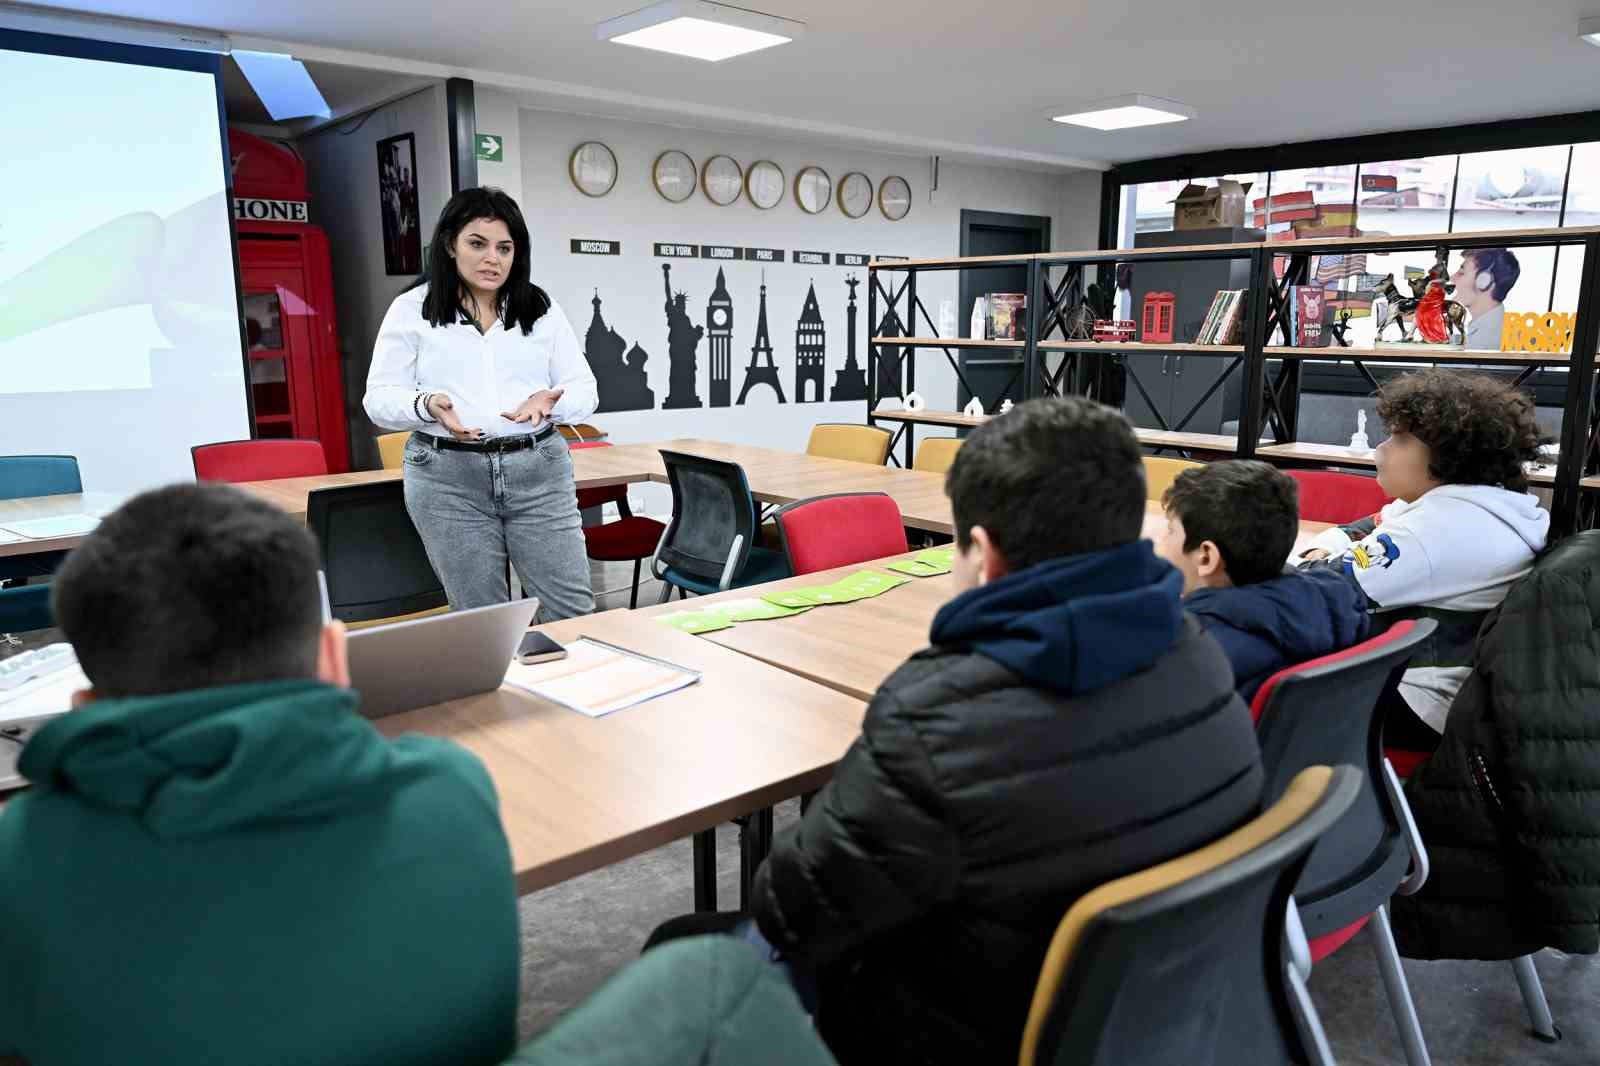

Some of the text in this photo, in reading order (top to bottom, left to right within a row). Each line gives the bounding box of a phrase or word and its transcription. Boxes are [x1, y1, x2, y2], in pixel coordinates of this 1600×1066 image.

[580, 241, 611, 253] MOSCOW
[660, 245, 693, 257] NEW YORK
[710, 247, 735, 258] LONDON
[756, 250, 774, 260] PARIS
[844, 255, 863, 265] BERLIN
